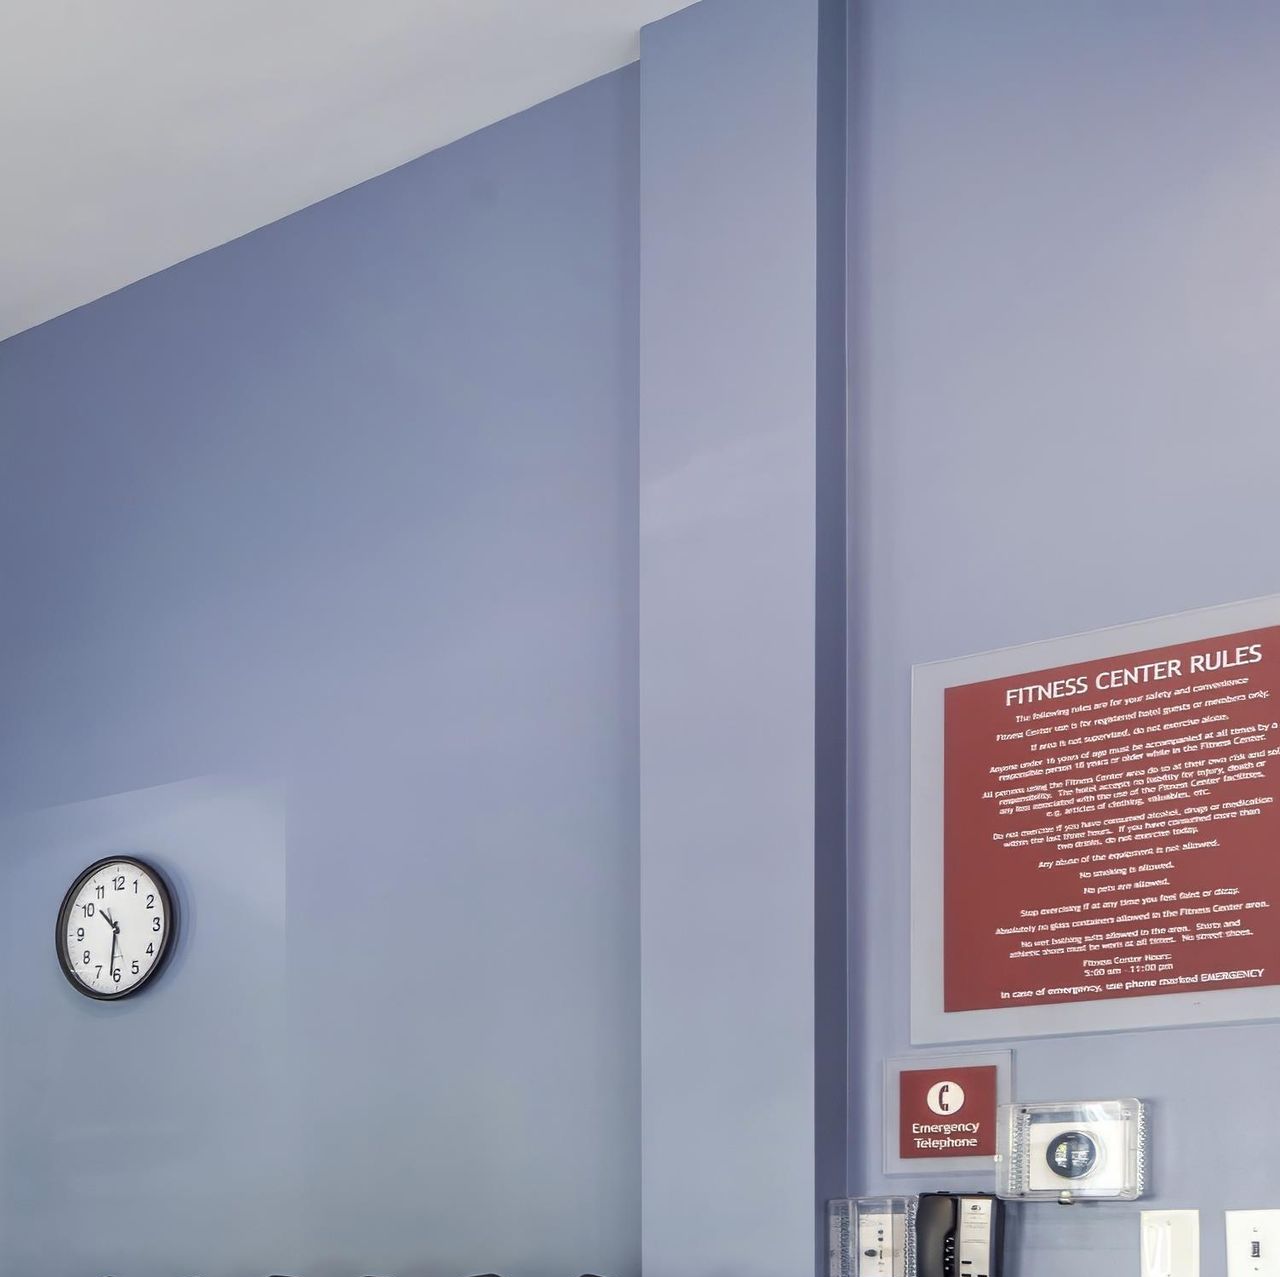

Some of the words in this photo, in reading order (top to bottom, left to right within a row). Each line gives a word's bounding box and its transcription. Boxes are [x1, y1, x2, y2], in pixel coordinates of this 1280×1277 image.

[1005, 676, 1087, 706] FITNESS
[1095, 659, 1182, 689] CENTER
[1190, 643, 1262, 673] RULES
[112, 876, 125, 891] 12
[133, 879, 138, 894] 1
[95, 885, 105, 899] 11
[146, 894, 155, 909] 2
[82, 902, 94, 918] 10
[152, 917, 161, 932] 3
[77, 927, 84, 942] 9
[83, 950, 90, 964] 8
[146, 943, 154, 956] 4
[95, 965, 103, 979] 7
[131, 960, 139, 975] 5
[113, 968, 121, 983] 6
[1035, 987, 1045, 995] of
[1047, 984, 1102, 995] emergency,
[1124, 979, 1157, 989] phone
[1158, 974, 1198, 985] marked
[1200, 968, 1264, 982] EMERGENCY
[912, 1122, 980, 1134] Emergency
[913, 1137, 978, 1150] Telephone
